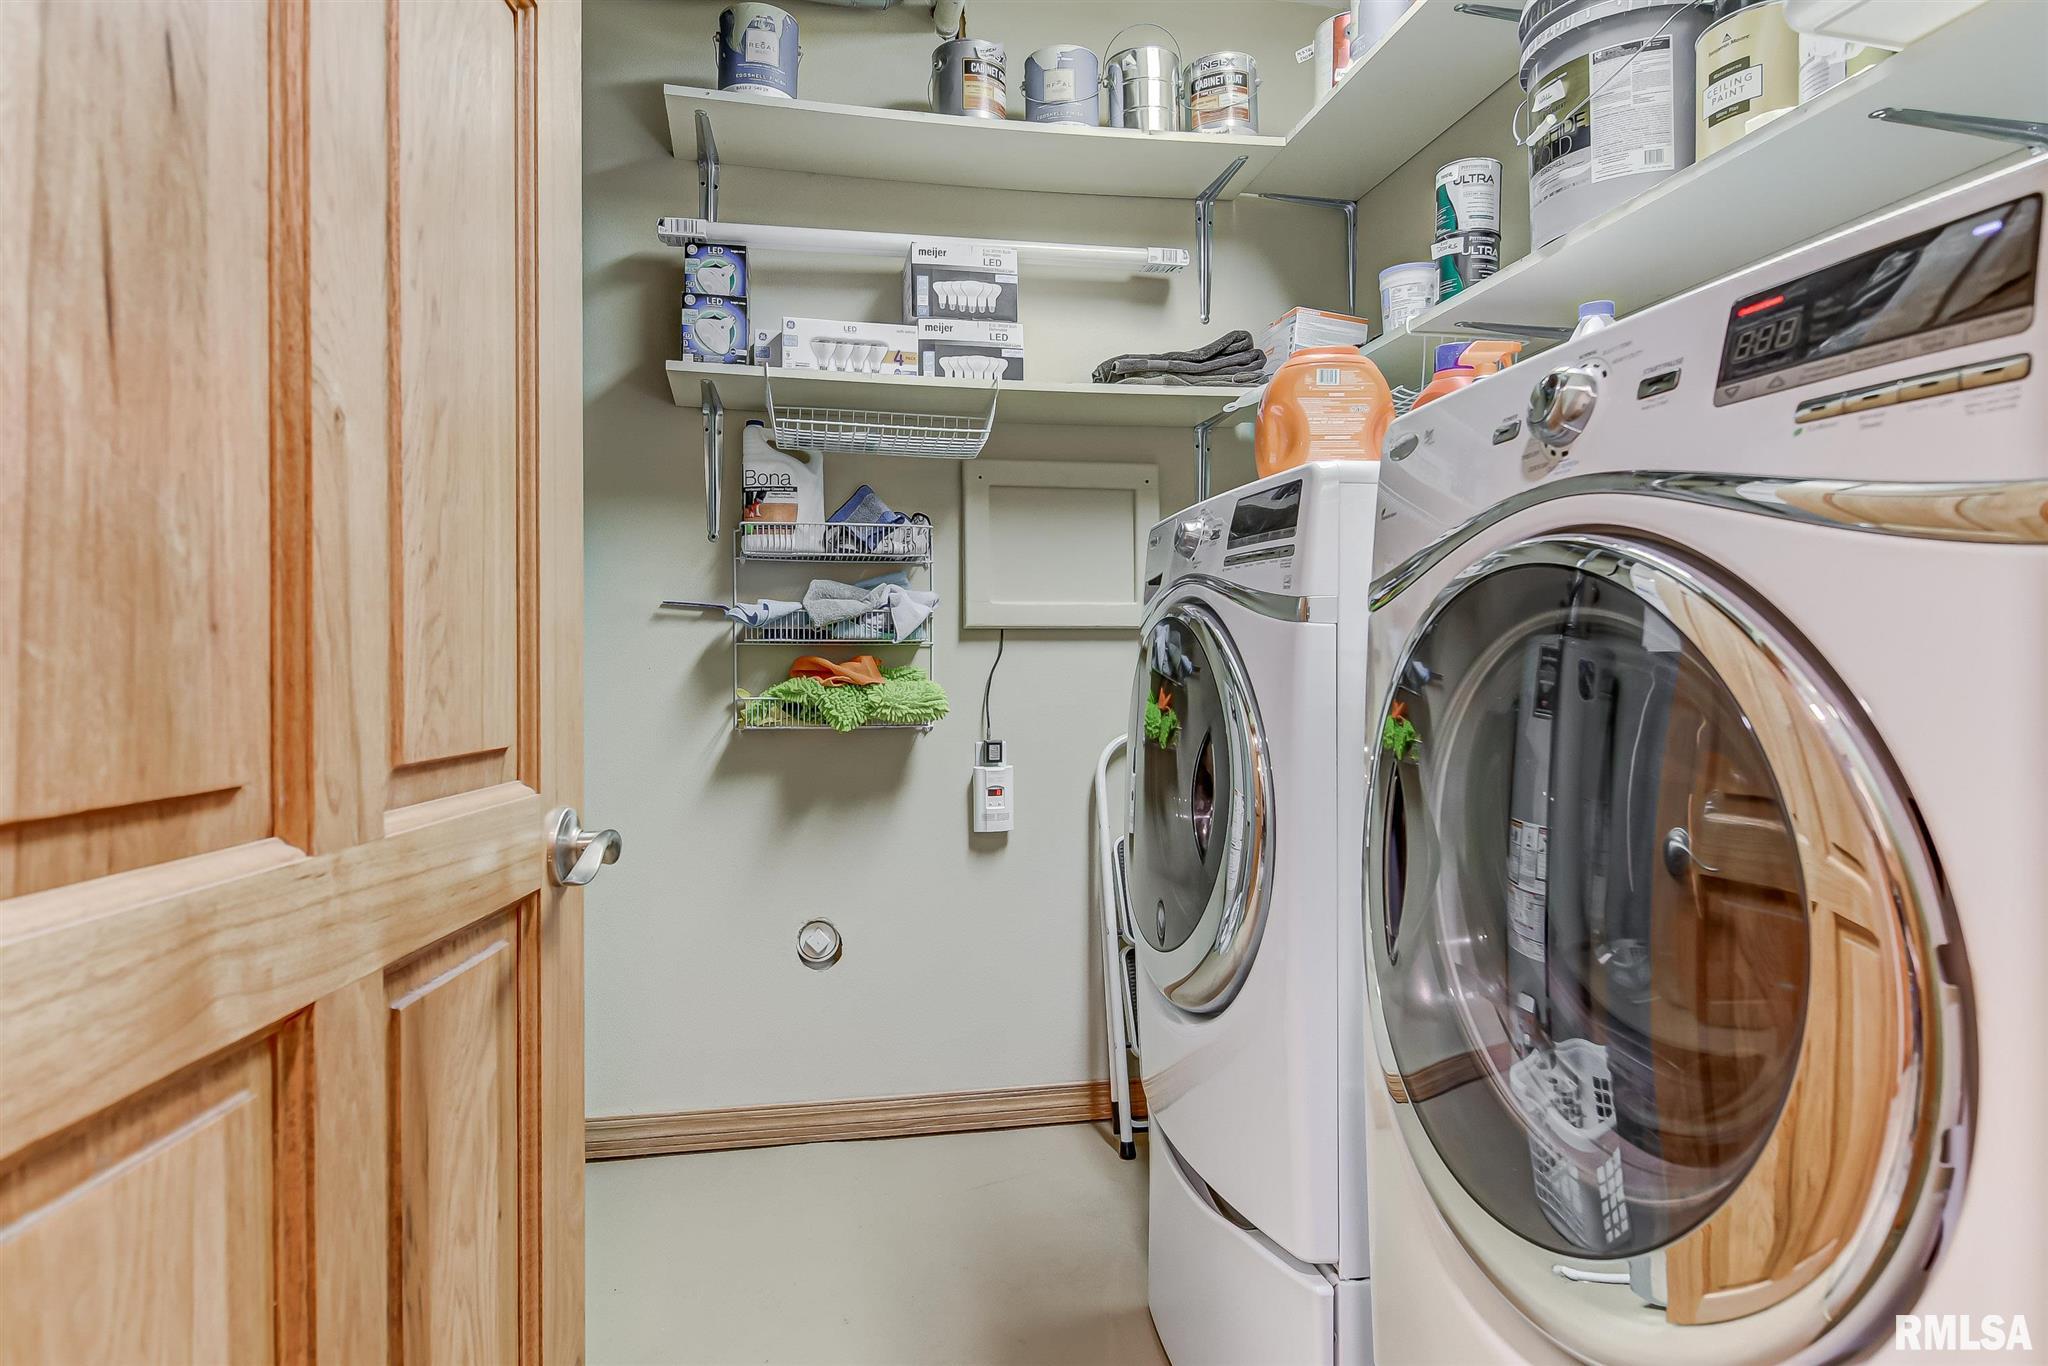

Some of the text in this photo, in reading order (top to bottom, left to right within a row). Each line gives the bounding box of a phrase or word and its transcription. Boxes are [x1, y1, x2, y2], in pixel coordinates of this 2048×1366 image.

[970, 61, 998, 79] CABINET
[1200, 57, 1236, 71] INSL-X
[1194, 75, 1225, 92] CABINET
[1226, 74, 1243, 85] COAT
[1707, 72, 1753, 99] CEILING
[1711, 85, 1745, 106] PAINT
[1453, 173, 1495, 186] ULTRA
[707, 246, 724, 255] LED
[918, 247, 947, 259] meijer
[1461, 245, 1499, 257] ULTRA
[983, 257, 1002, 267] LED
[706, 297, 724, 306] LED
[843, 325, 857, 333] LED
[924, 322, 954, 334] meijer
[989, 333, 1009, 342] LED
[893, 350, 904, 367] 4
[745, 469, 792, 486] Bona
